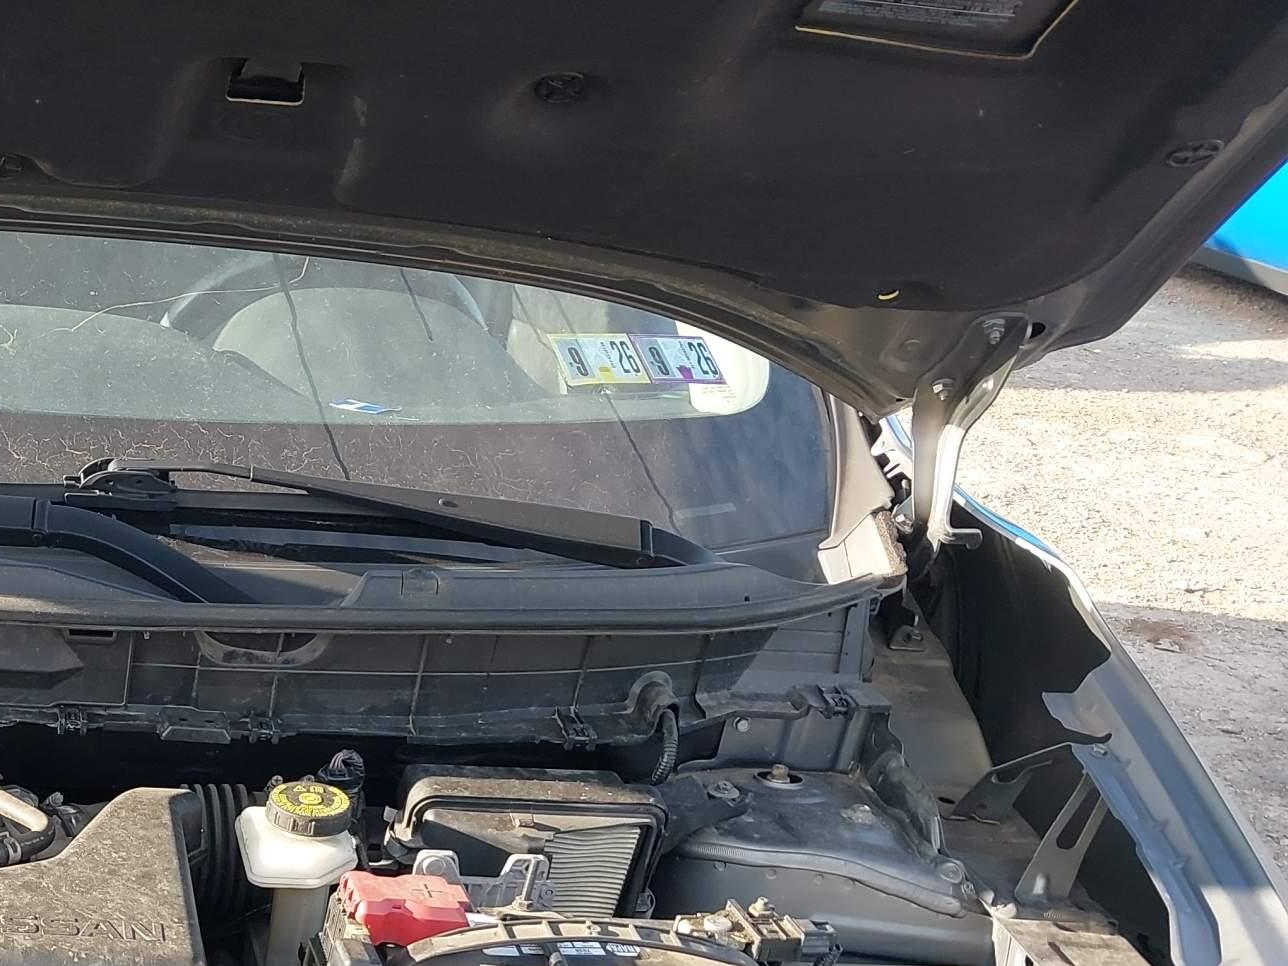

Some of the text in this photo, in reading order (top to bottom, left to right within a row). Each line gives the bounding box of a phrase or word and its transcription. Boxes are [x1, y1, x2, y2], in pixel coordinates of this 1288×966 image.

[567, 347, 590, 377] 9
[610, 340, 641, 374] 26
[648, 346, 671, 376] 9
[688, 341, 719, 376] 26
